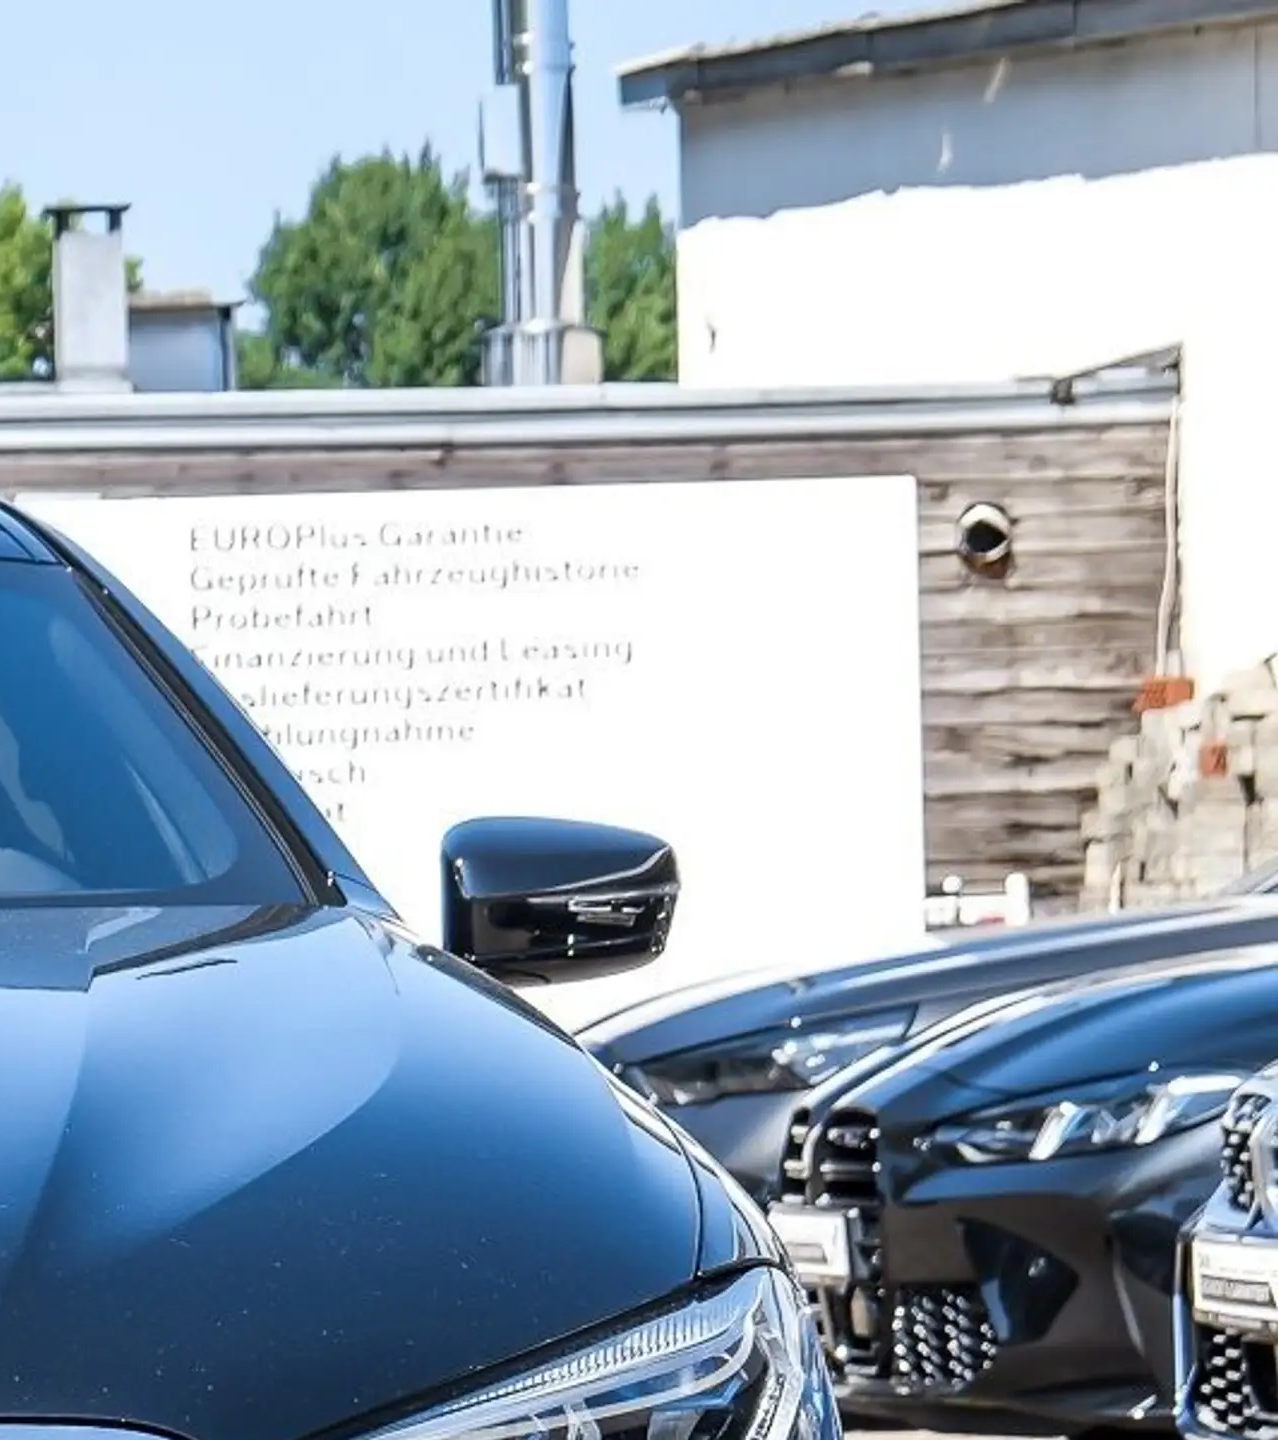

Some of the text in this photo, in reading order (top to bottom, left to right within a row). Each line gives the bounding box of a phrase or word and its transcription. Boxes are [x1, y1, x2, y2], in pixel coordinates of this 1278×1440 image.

[190, 522, 524, 552] EUROPlus Garantie
[191, 602, 373, 631] Probefahrt
[426, 640, 489, 664] und
[500, 638, 633, 665] Leasing
[242, 676, 588, 709] slieferungszertifikat
